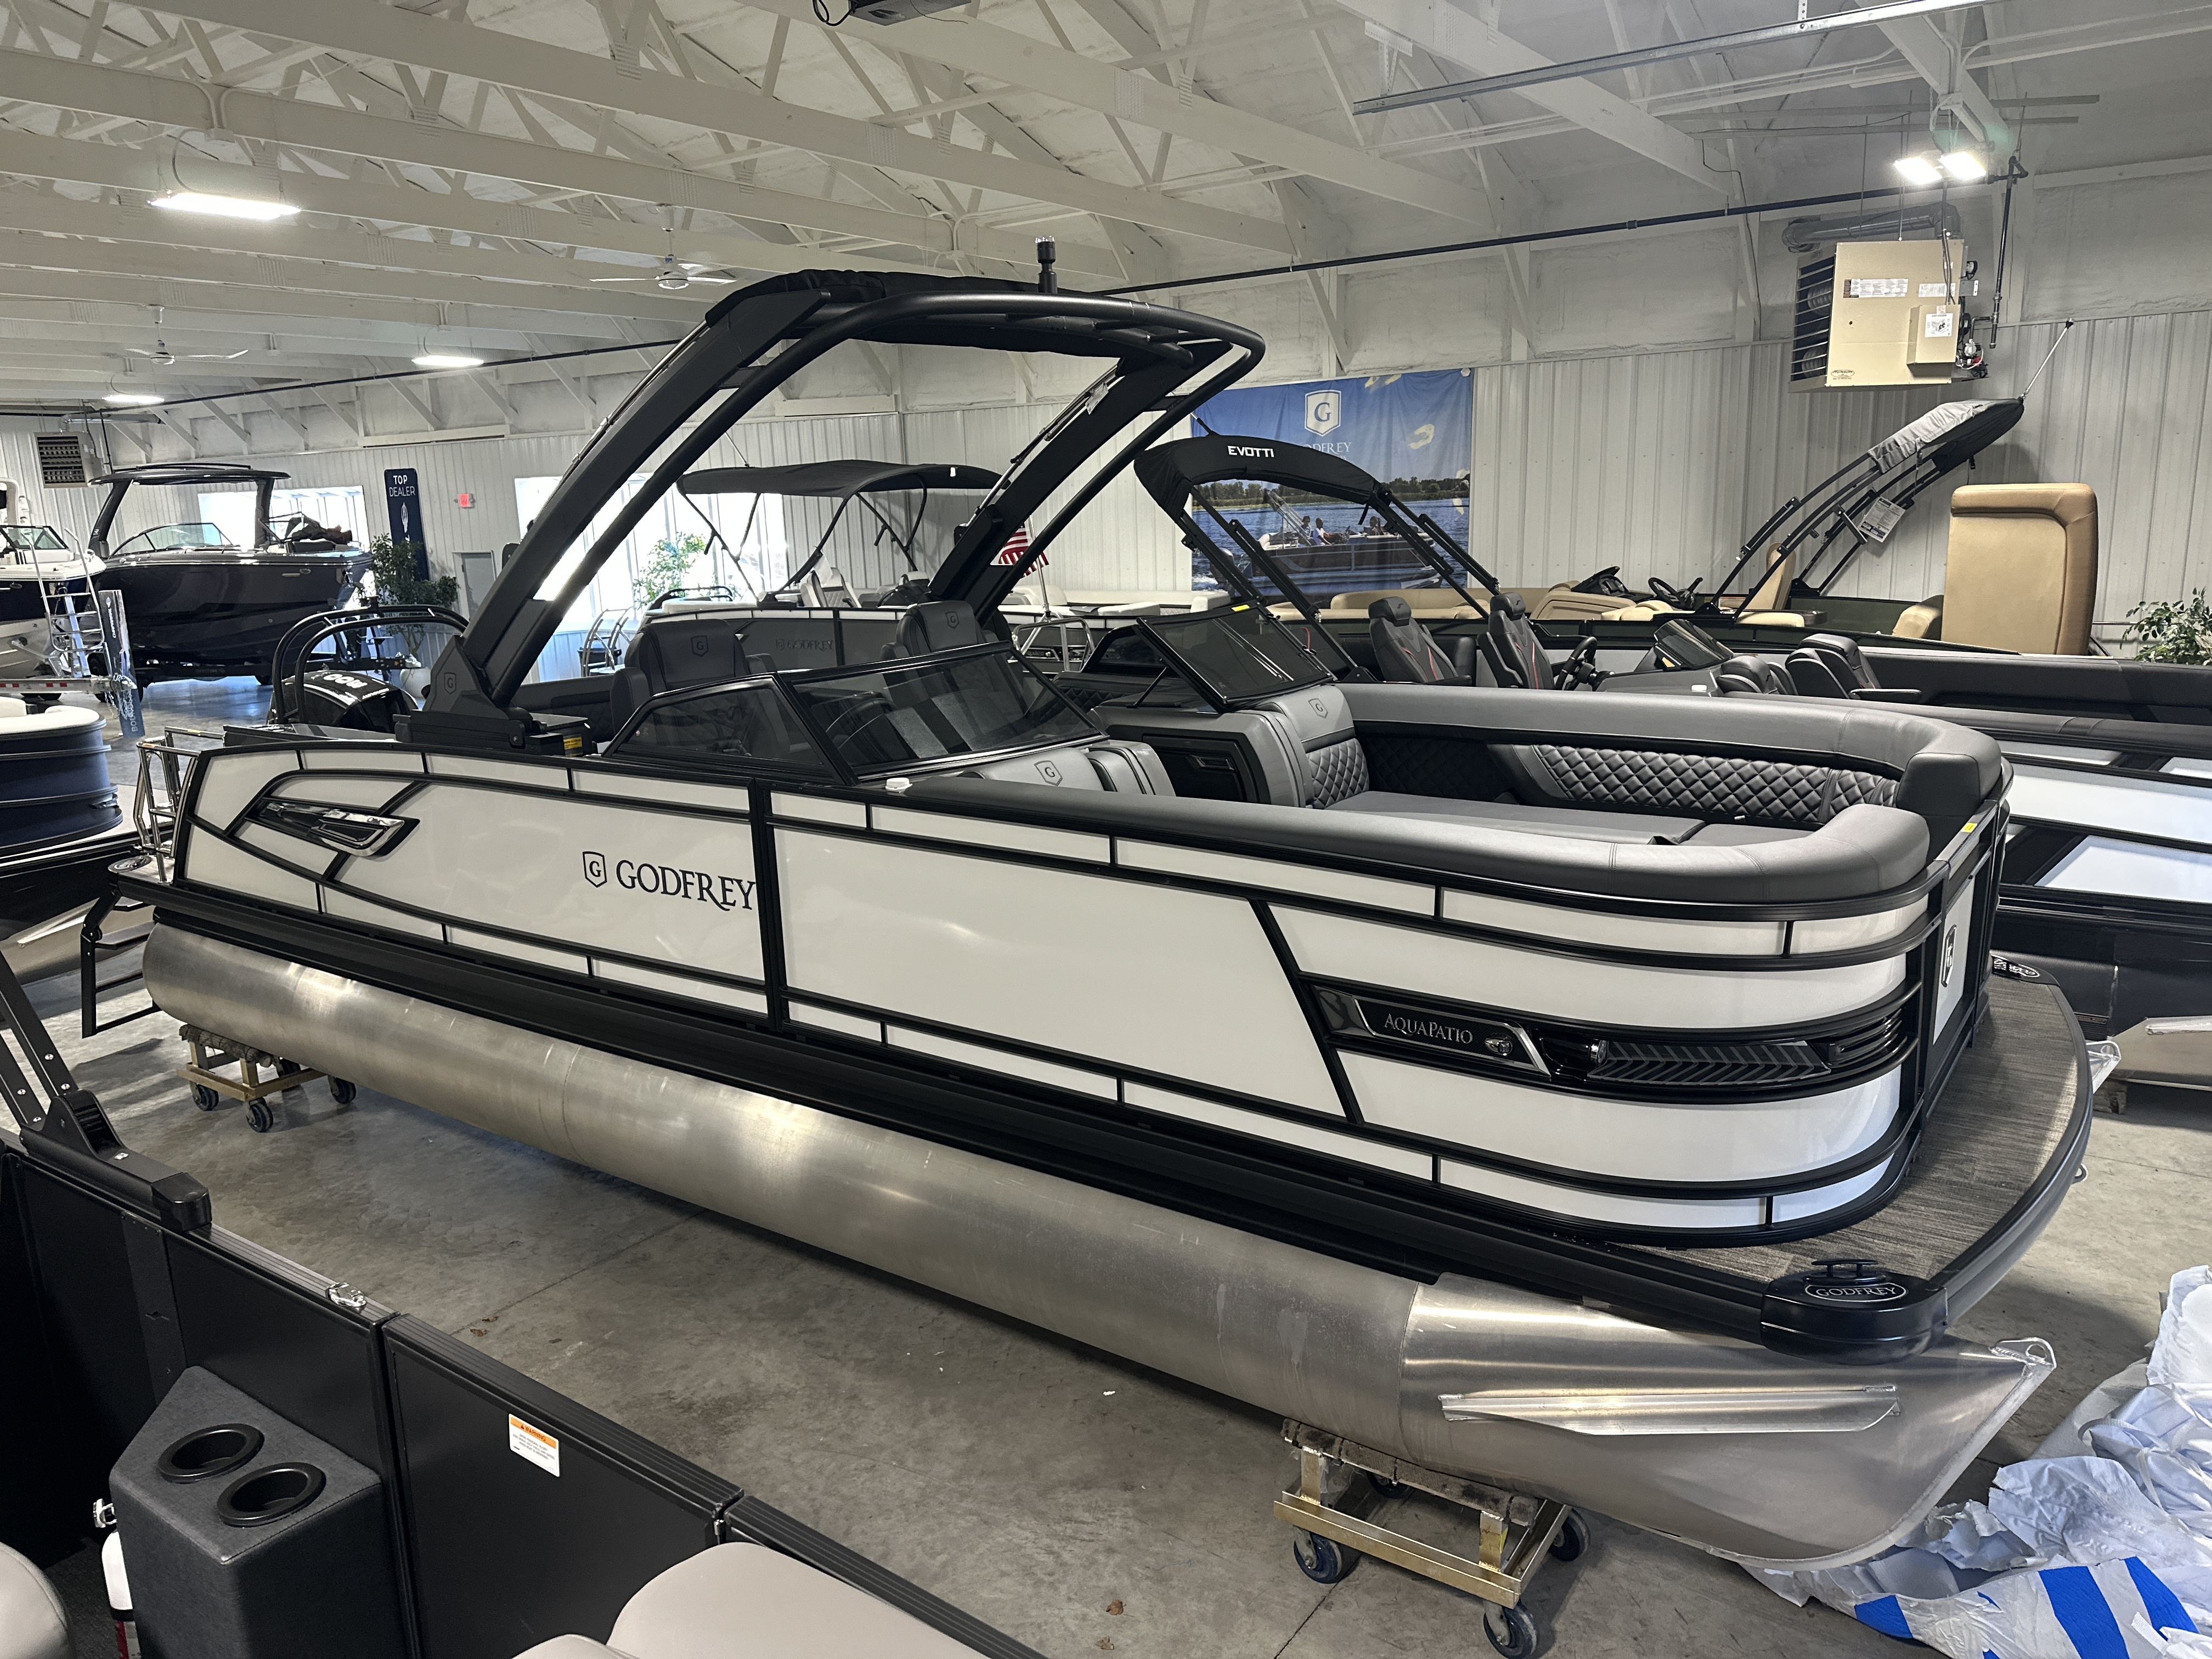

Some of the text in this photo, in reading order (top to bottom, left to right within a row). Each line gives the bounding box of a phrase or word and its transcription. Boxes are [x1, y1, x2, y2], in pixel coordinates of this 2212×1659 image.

[1314, 402, 1331, 422] G
[1227, 445, 1274, 458] EVOTTI
[393, 475, 408, 485] TOP
[389, 486, 416, 496] DEALER
[589, 860, 756, 911] G GODFREY
[1815, 1287, 1897, 1296] GODFREY
[524, 1426, 546, 1442] WARNING
